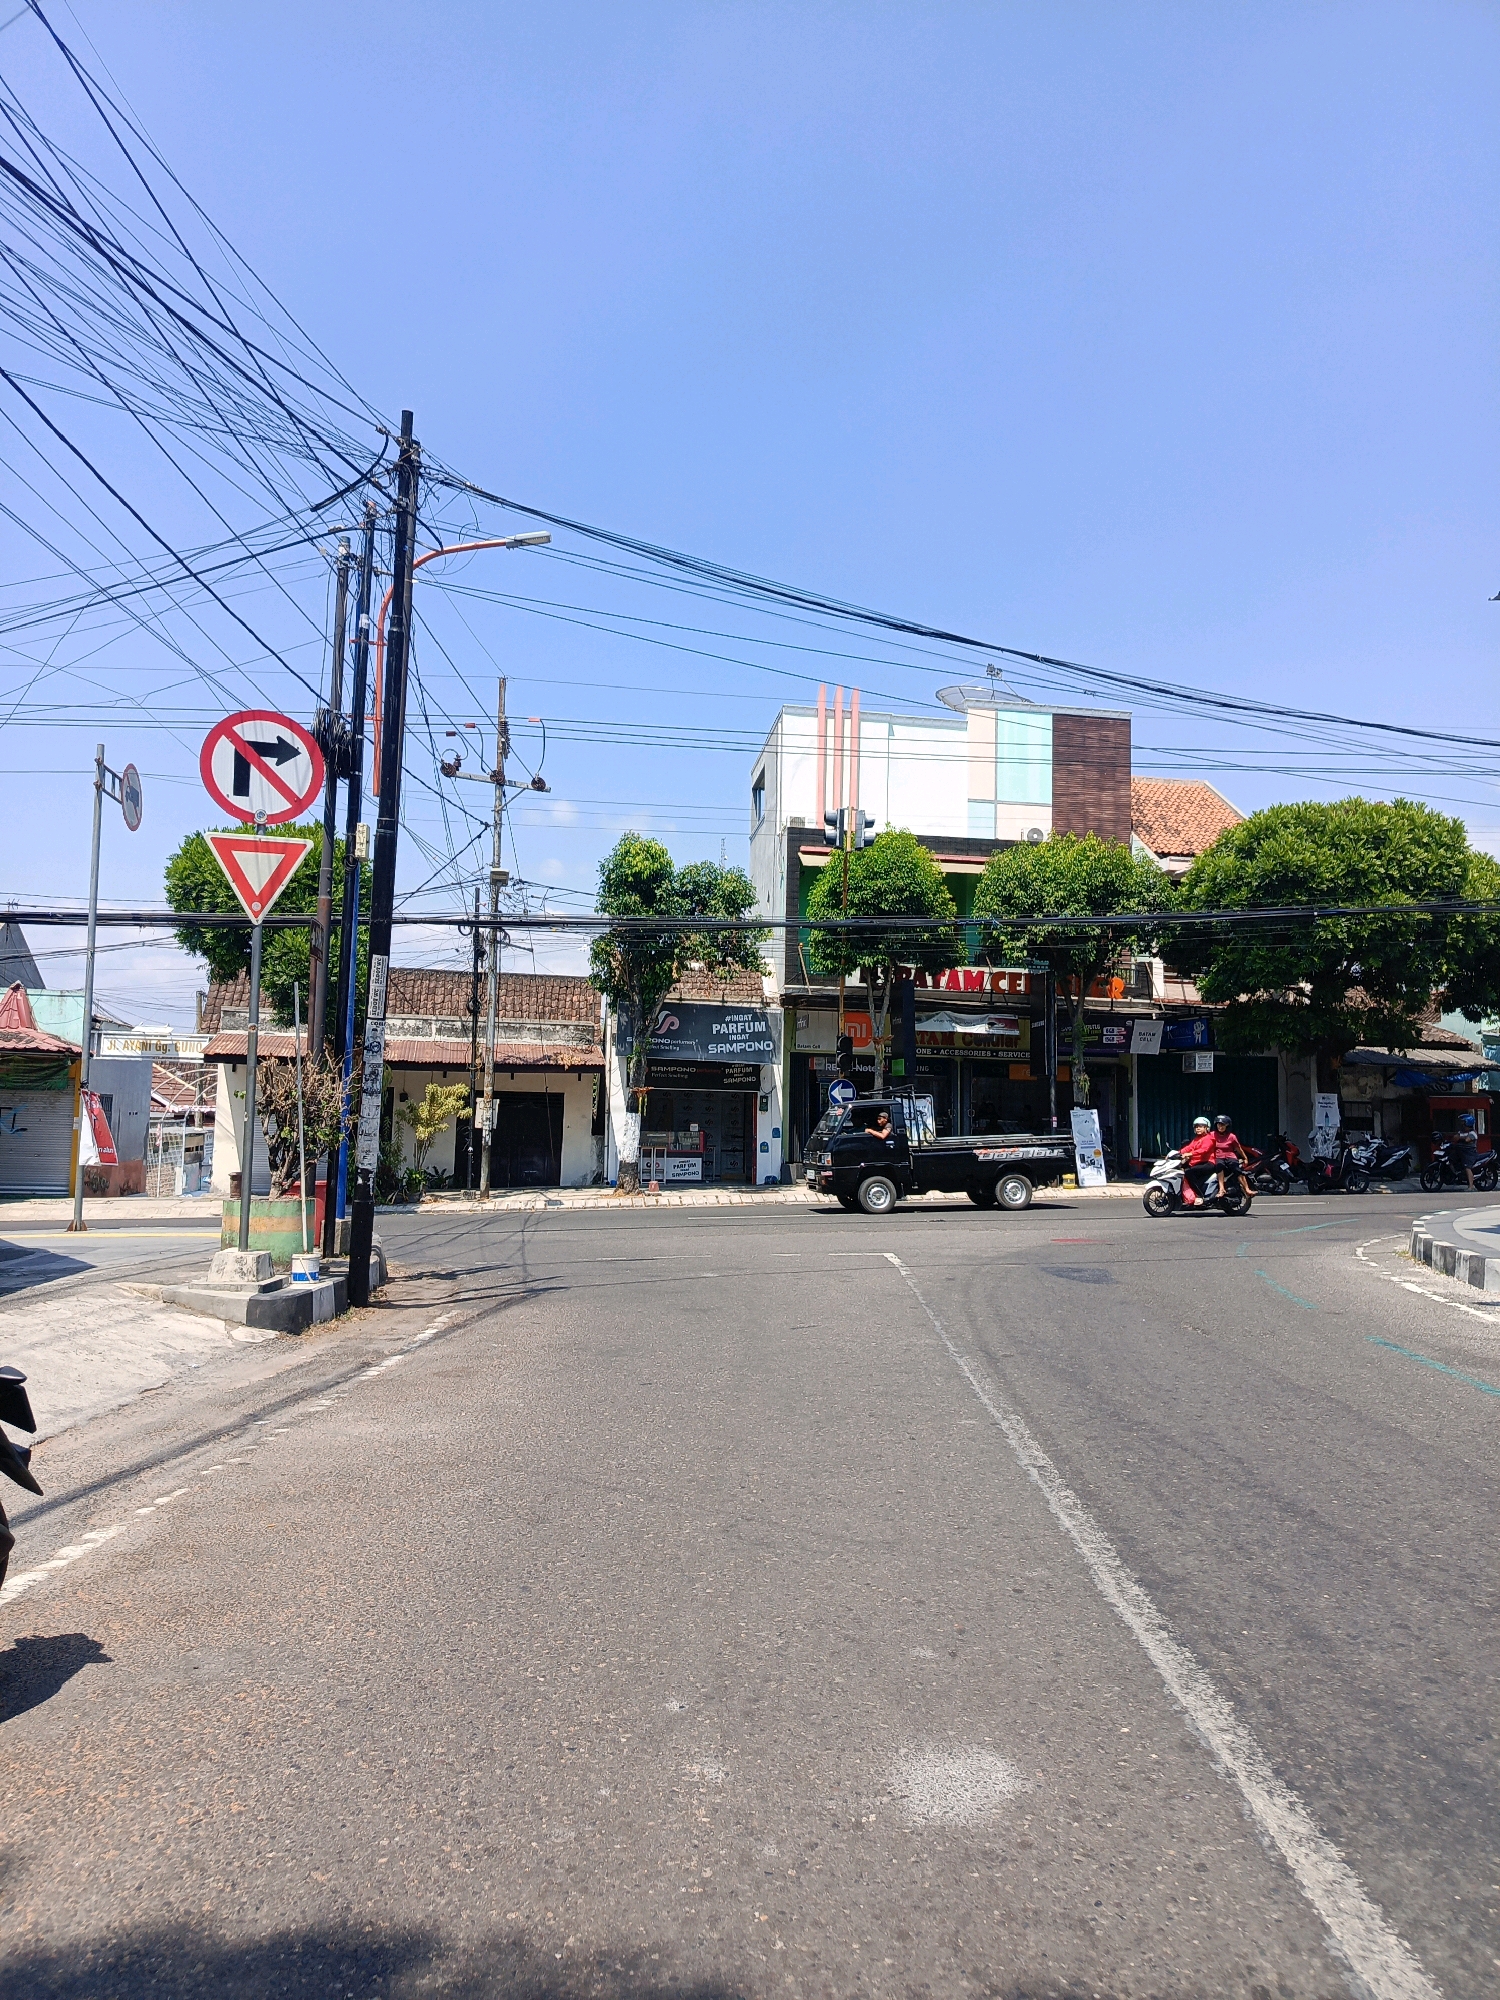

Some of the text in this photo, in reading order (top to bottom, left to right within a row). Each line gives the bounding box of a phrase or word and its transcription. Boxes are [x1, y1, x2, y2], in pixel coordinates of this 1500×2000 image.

[725, 1013, 753, 1022] #INGAT
[712, 1021, 767, 1035] PARFUM
[626, 1036, 671, 1044] SONO
[728, 1033, 750, 1041] INGAT
[155, 1041, 171, 1054] Gg.
[707, 1040, 774, 1054] SAMPONO
[939, 1048, 991, 1057] ACCESSORIES
[725, 1066, 753, 1075] PARFUM
[723, 1076, 757, 1084] SAMPONO
